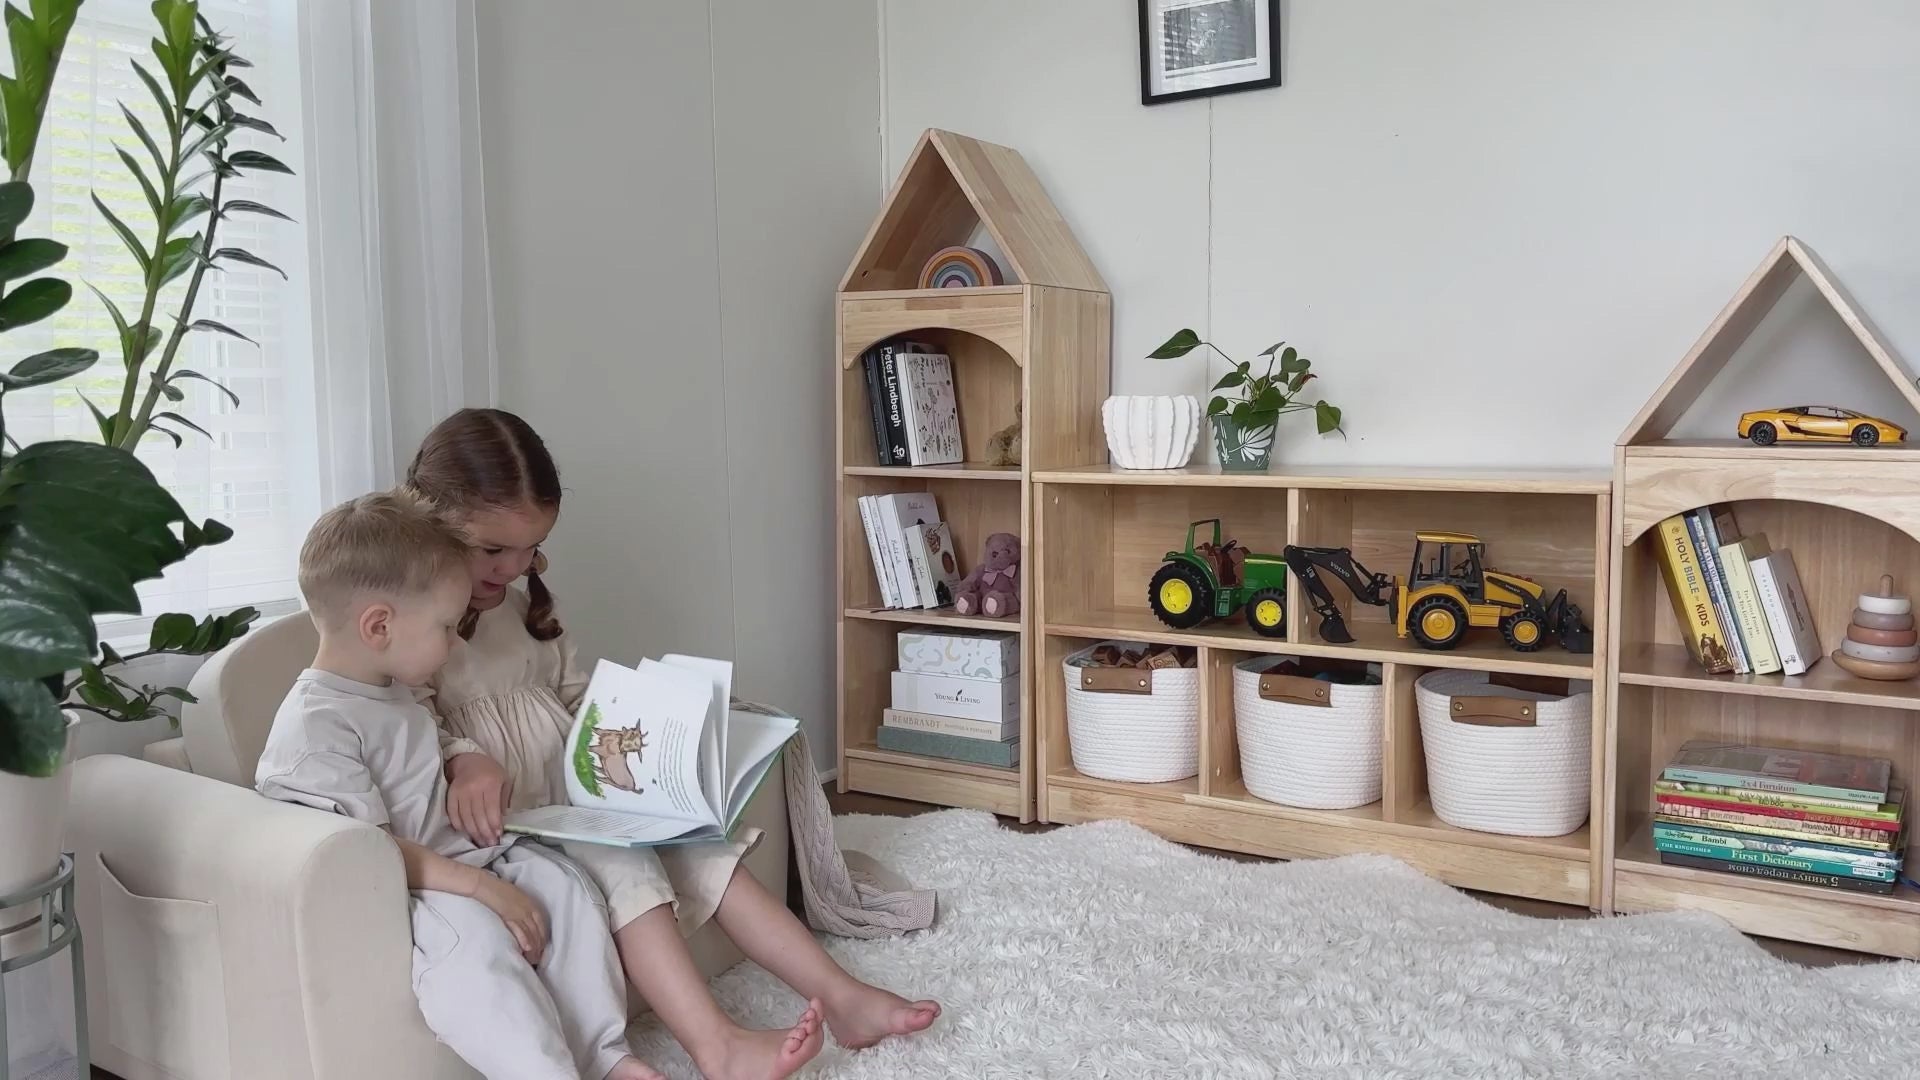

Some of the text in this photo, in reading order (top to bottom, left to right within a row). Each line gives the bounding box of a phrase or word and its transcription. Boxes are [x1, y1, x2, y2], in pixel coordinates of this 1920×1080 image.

[884, 346, 901, 427] Peter Lindbergh
[1330, 561, 1350, 577] VOLVO
[1675, 537, 1690, 564] HOLY
[1684, 566, 1699, 594] BIBLE
[1696, 603, 1709, 627] KIDS
[934, 693, 955, 701] YOUNG
[960, 695, 981, 704] LIVING
[892, 715, 940, 728] REMBRANDT
[1760, 781, 1797, 792] Furniture
[1702, 835, 1727, 845] Bambi
[1675, 843, 1711, 853] KINGFISHER
[1731, 849, 1813, 869] First Dictionary
[1728, 864, 1839, 887] 5 минут перед сном
